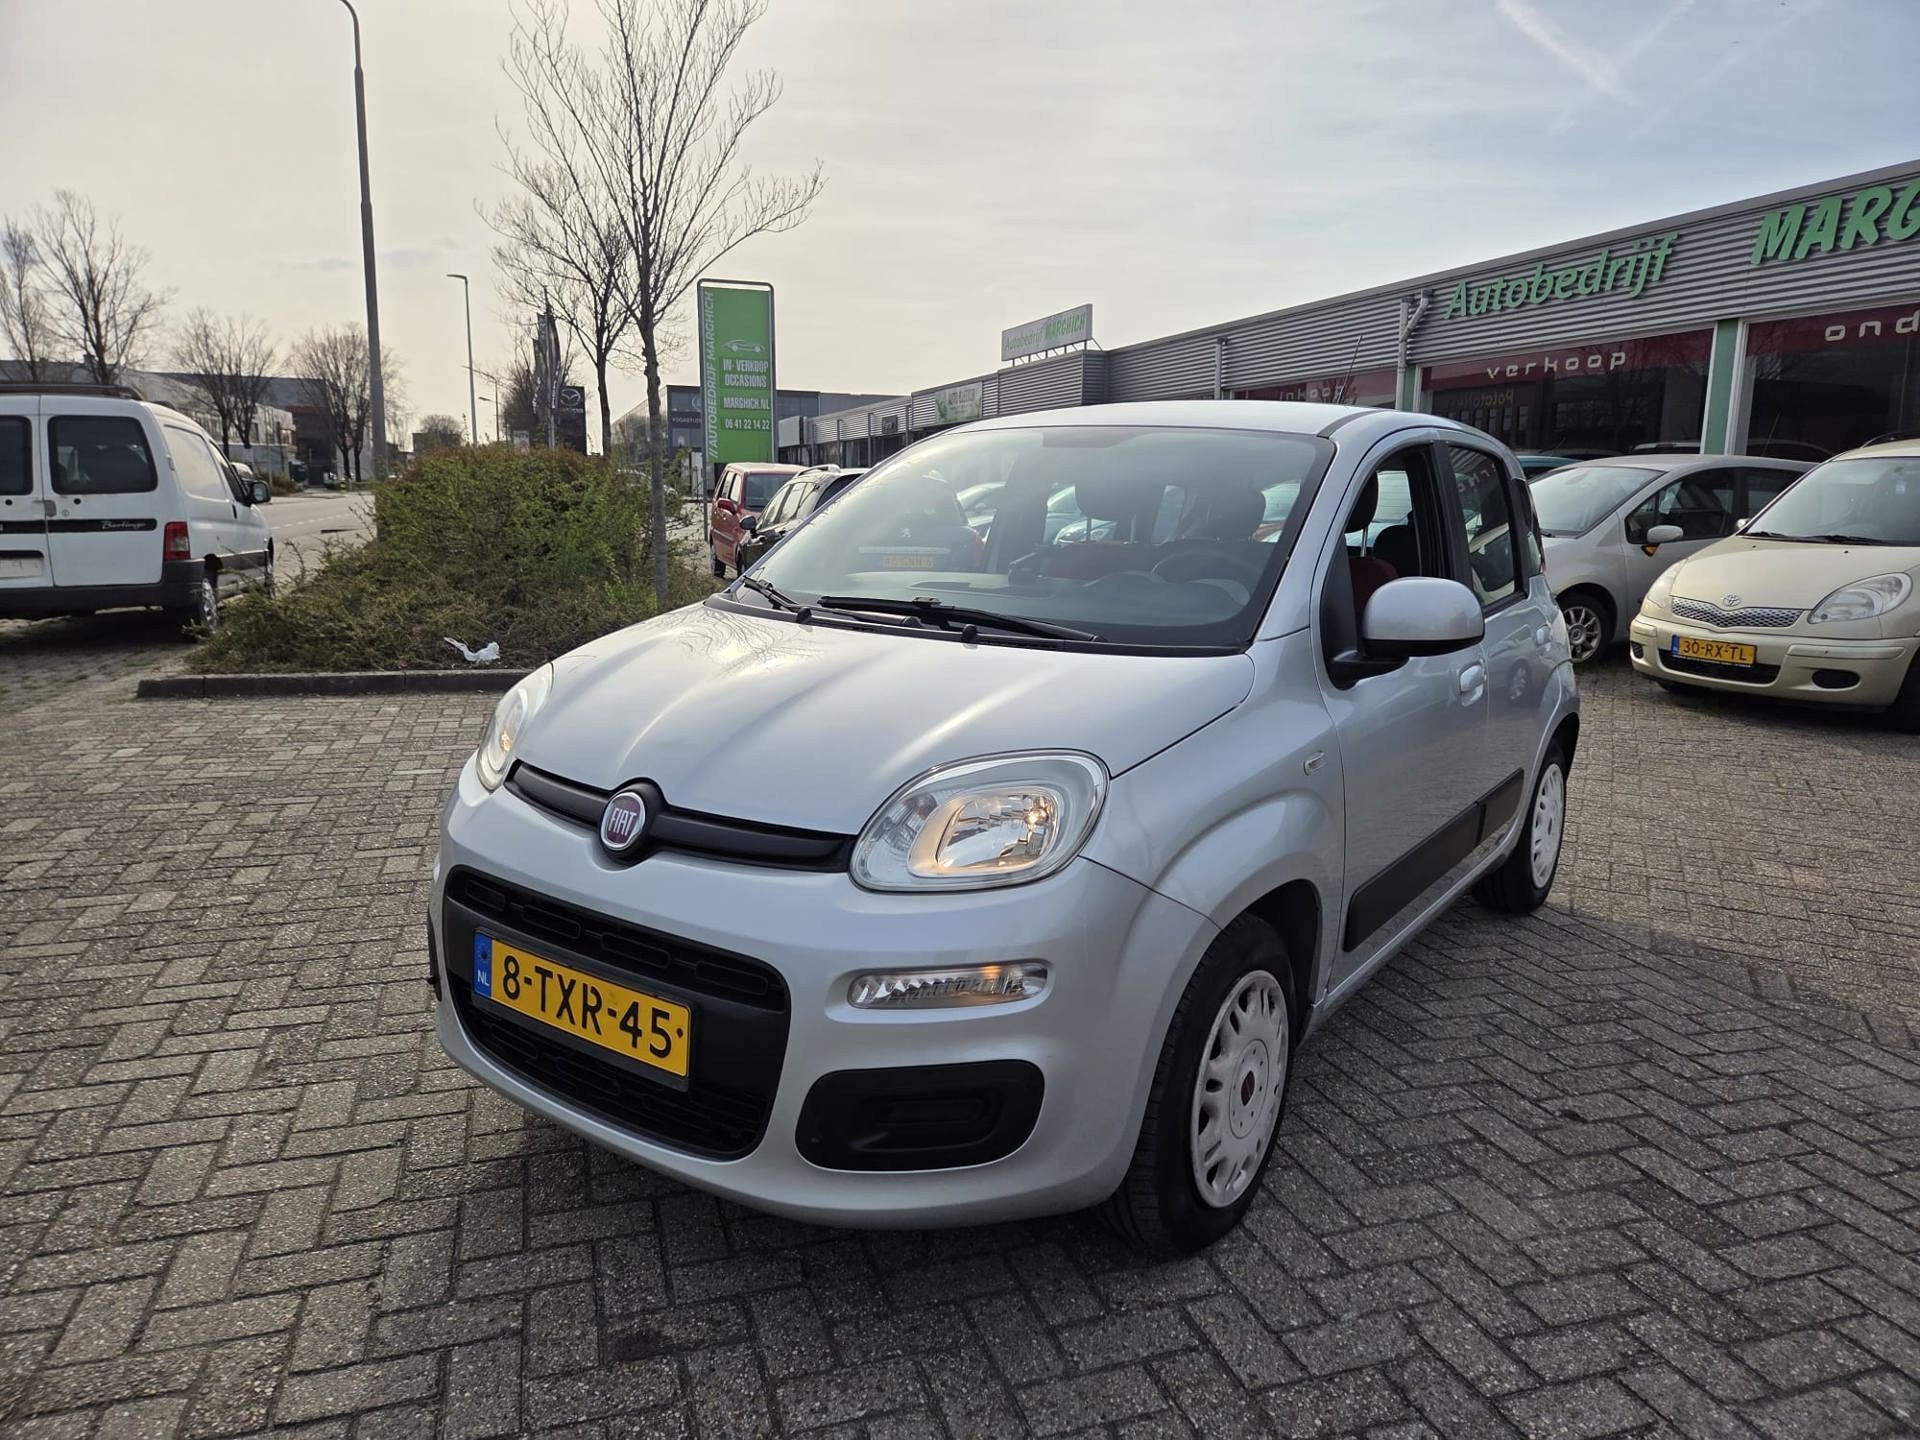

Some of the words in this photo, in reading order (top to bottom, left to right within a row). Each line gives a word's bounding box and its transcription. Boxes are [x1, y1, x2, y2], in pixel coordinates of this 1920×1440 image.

[1444, 232, 1679, 320] Autobedrijf
[1750, 177, 1920, 266] MARG
[705, 290, 715, 360] MARGHICH
[1824, 309, 1920, 342] ond
[735, 359, 769, 373] VERKOOP
[1487, 351, 1626, 379] verkoop
[725, 374, 767, 388] OCCASIONS
[723, 397, 770, 410] MARGHICH.NL
[102, 520, 146, 529] Berlingo
[1683, 640, 1748, 661] 30-RX-TL
[608, 807, 637, 836] FIAT
[477, 969, 490, 987] NL
[503, 955, 672, 1059] 8-TXR-45
